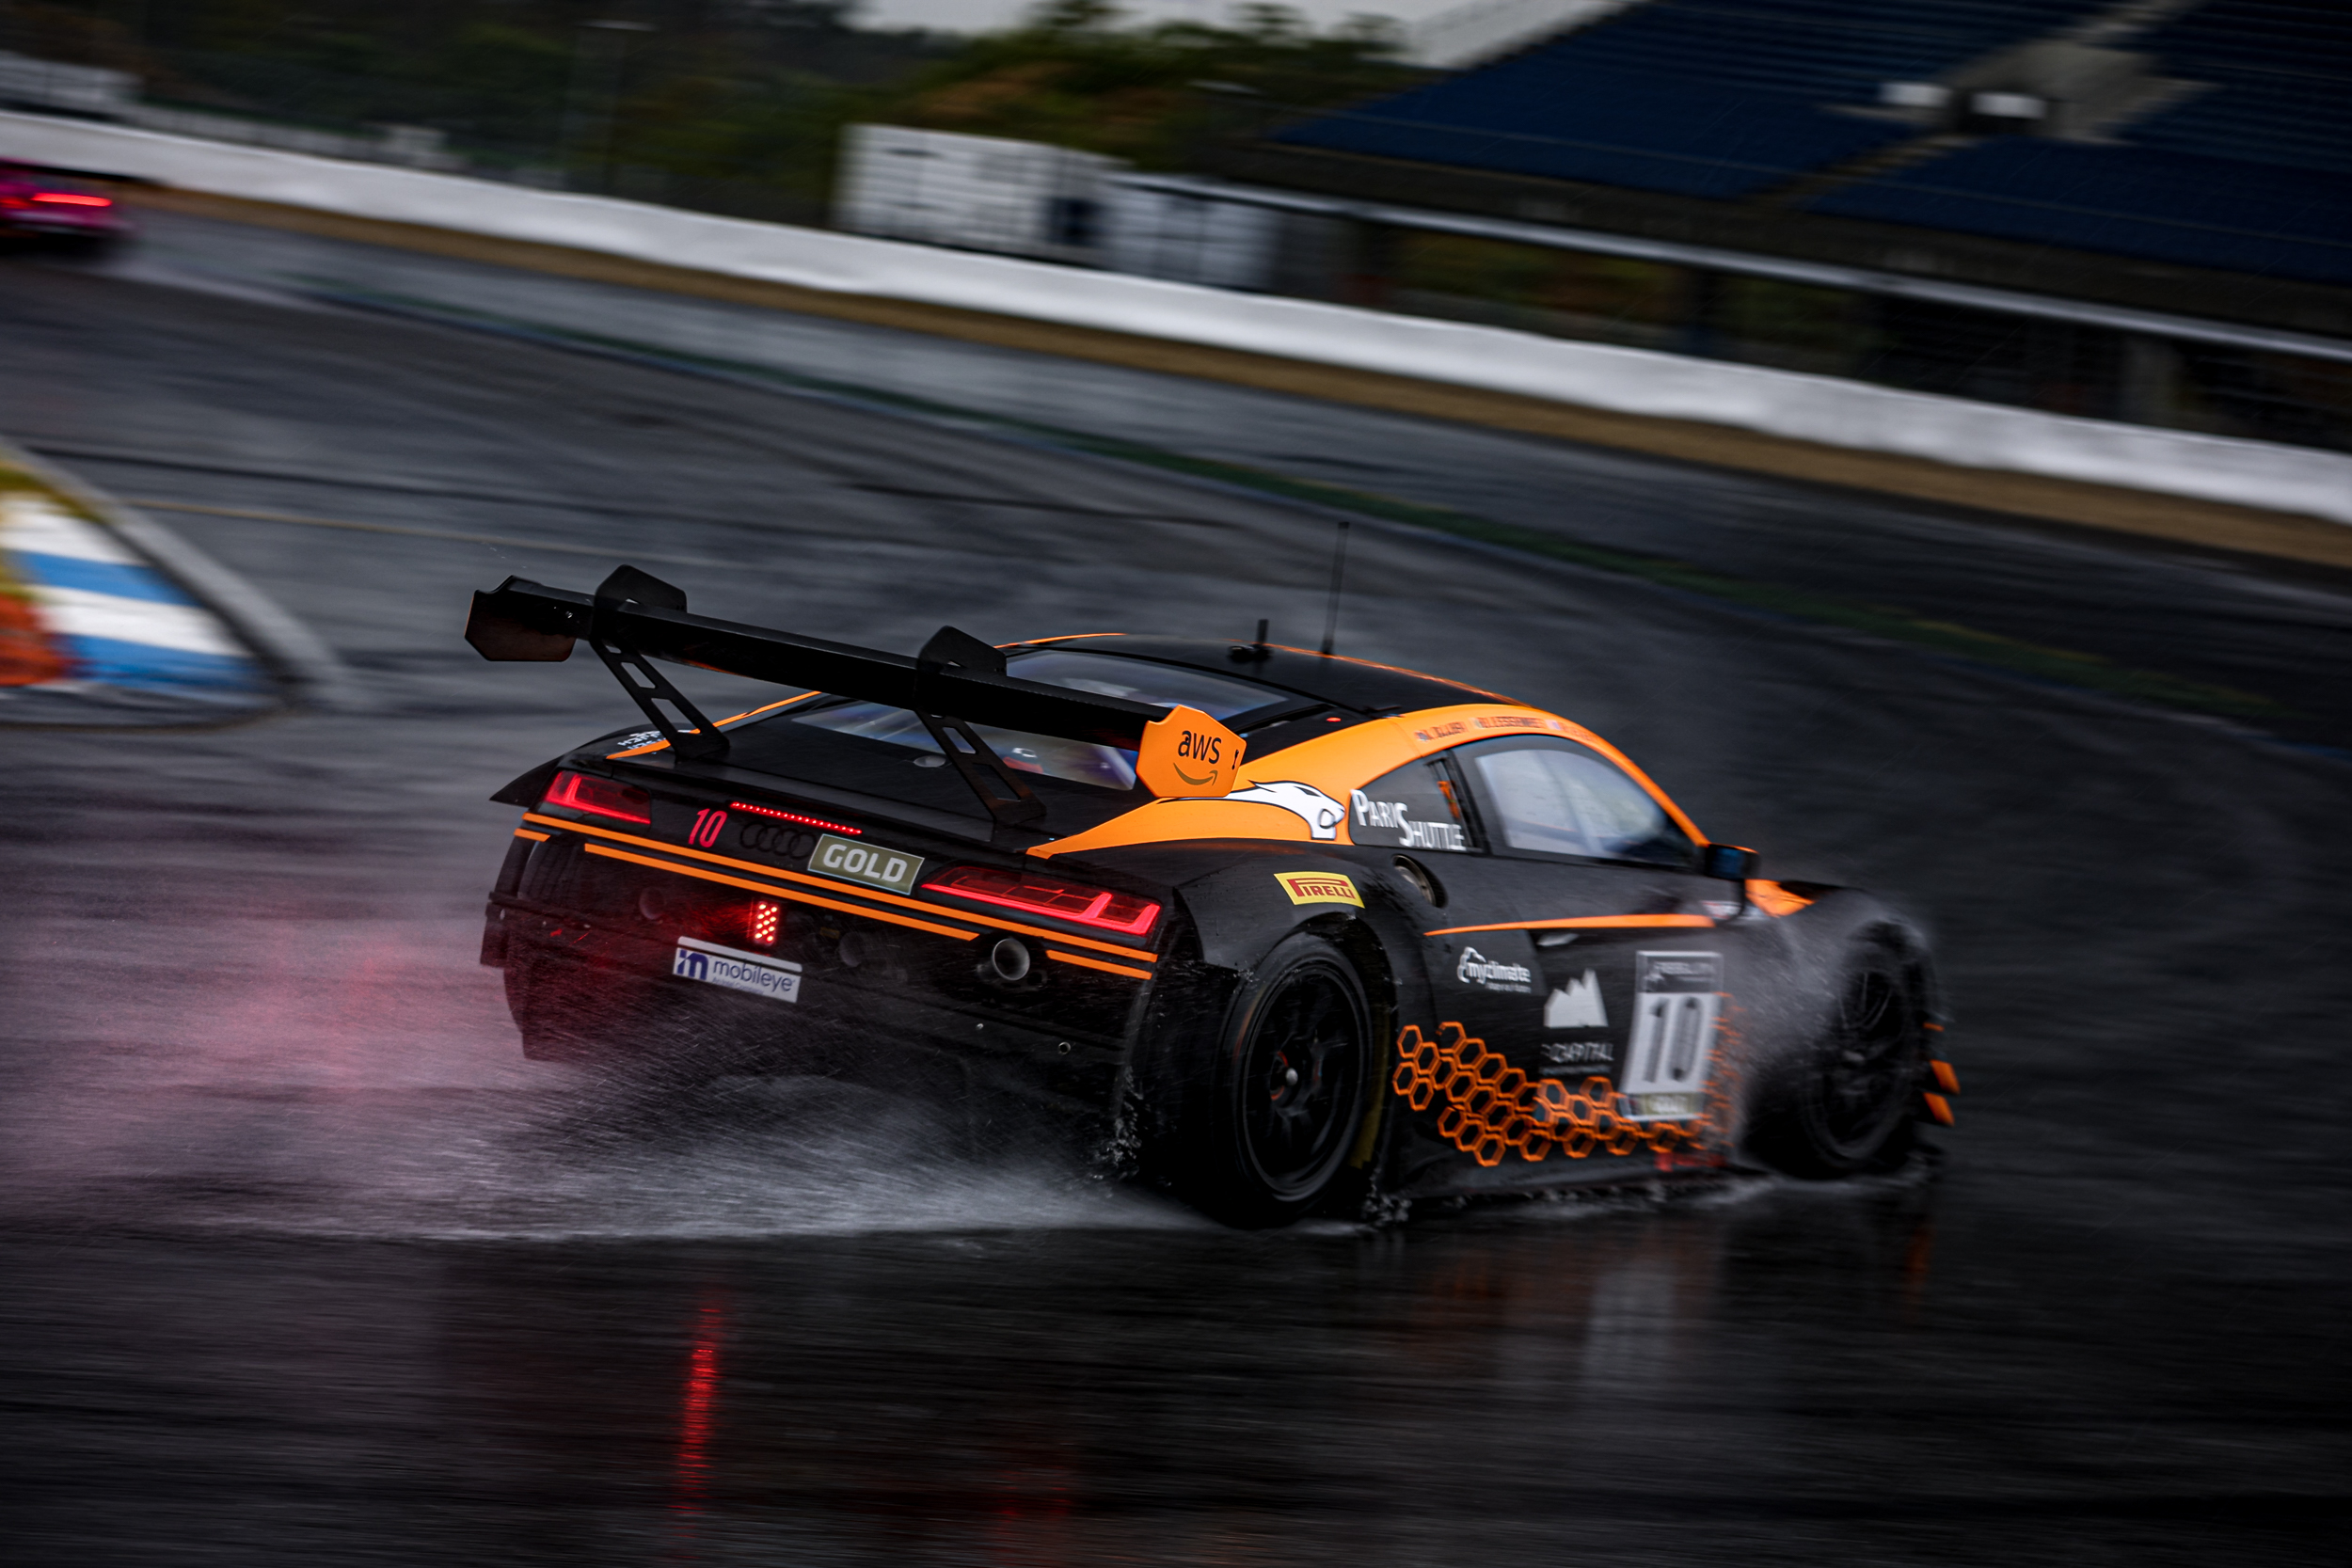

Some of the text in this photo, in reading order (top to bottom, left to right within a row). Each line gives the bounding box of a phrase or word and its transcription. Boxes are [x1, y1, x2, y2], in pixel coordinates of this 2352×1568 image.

[1178, 730, 1222, 764] aws
[688, 808, 728, 847] 10
[823, 844, 908, 883] GOLD
[1286, 878, 1356, 899] PIRELLI
[713, 958, 794, 992] mobileye
[1645, 996, 1705, 1083] 10
